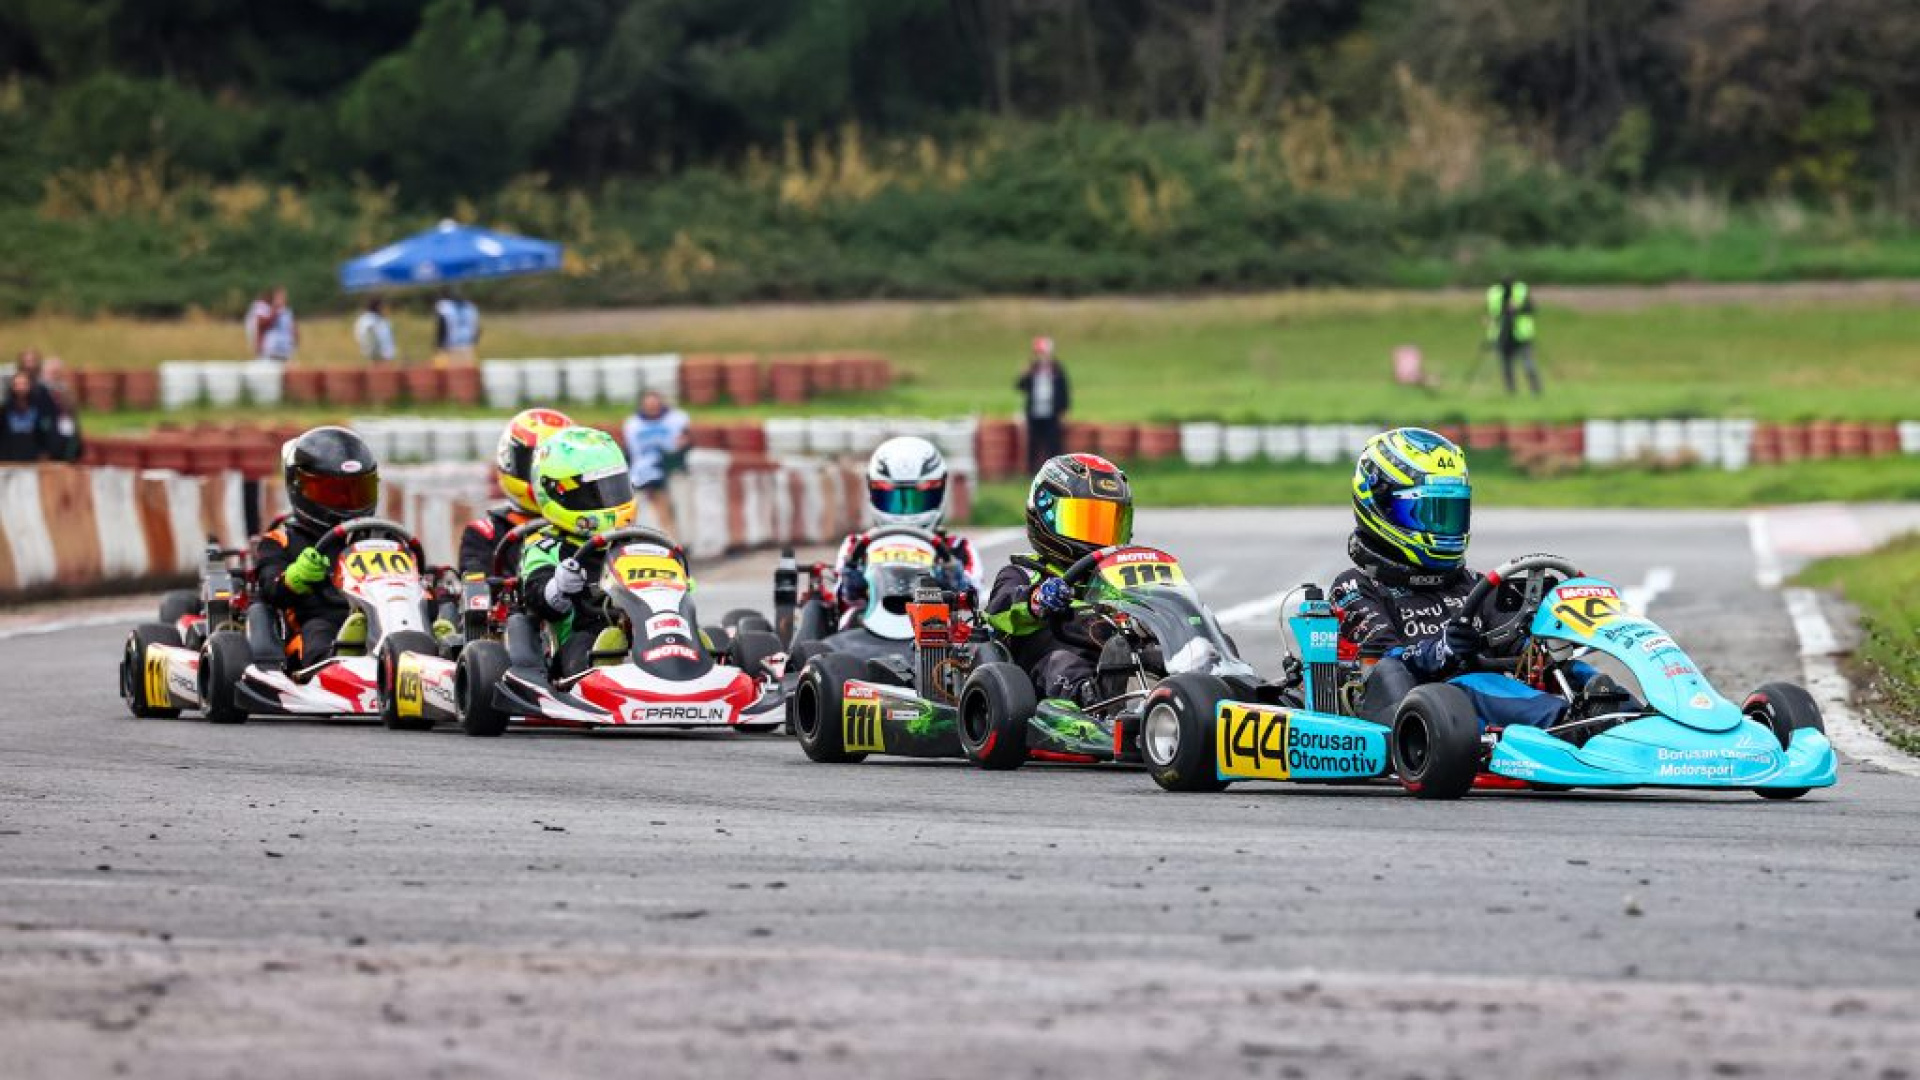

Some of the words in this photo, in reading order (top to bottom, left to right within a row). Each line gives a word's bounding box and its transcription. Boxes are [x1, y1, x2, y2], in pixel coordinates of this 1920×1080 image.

[1437, 456, 1456, 469] 44
[350, 552, 410, 575] 110
[1117, 552, 1160, 563] MOTUL
[627, 567, 678, 580] 103
[1119, 563, 1172, 587] 111
[1561, 587, 1613, 599] MOTUL
[645, 645, 698, 660] MOTUL
[847, 687, 873, 698] MOTUL
[646, 707, 724, 719] PAROLIN
[845, 703, 877, 745] 111
[1221, 708, 1288, 772] 144
[1288, 727, 1366, 751] Borusan
[1658, 747, 1717, 760] Borusan
[1289, 750, 1377, 773] Otomotiv
[1659, 764, 1734, 778] Motorsport
